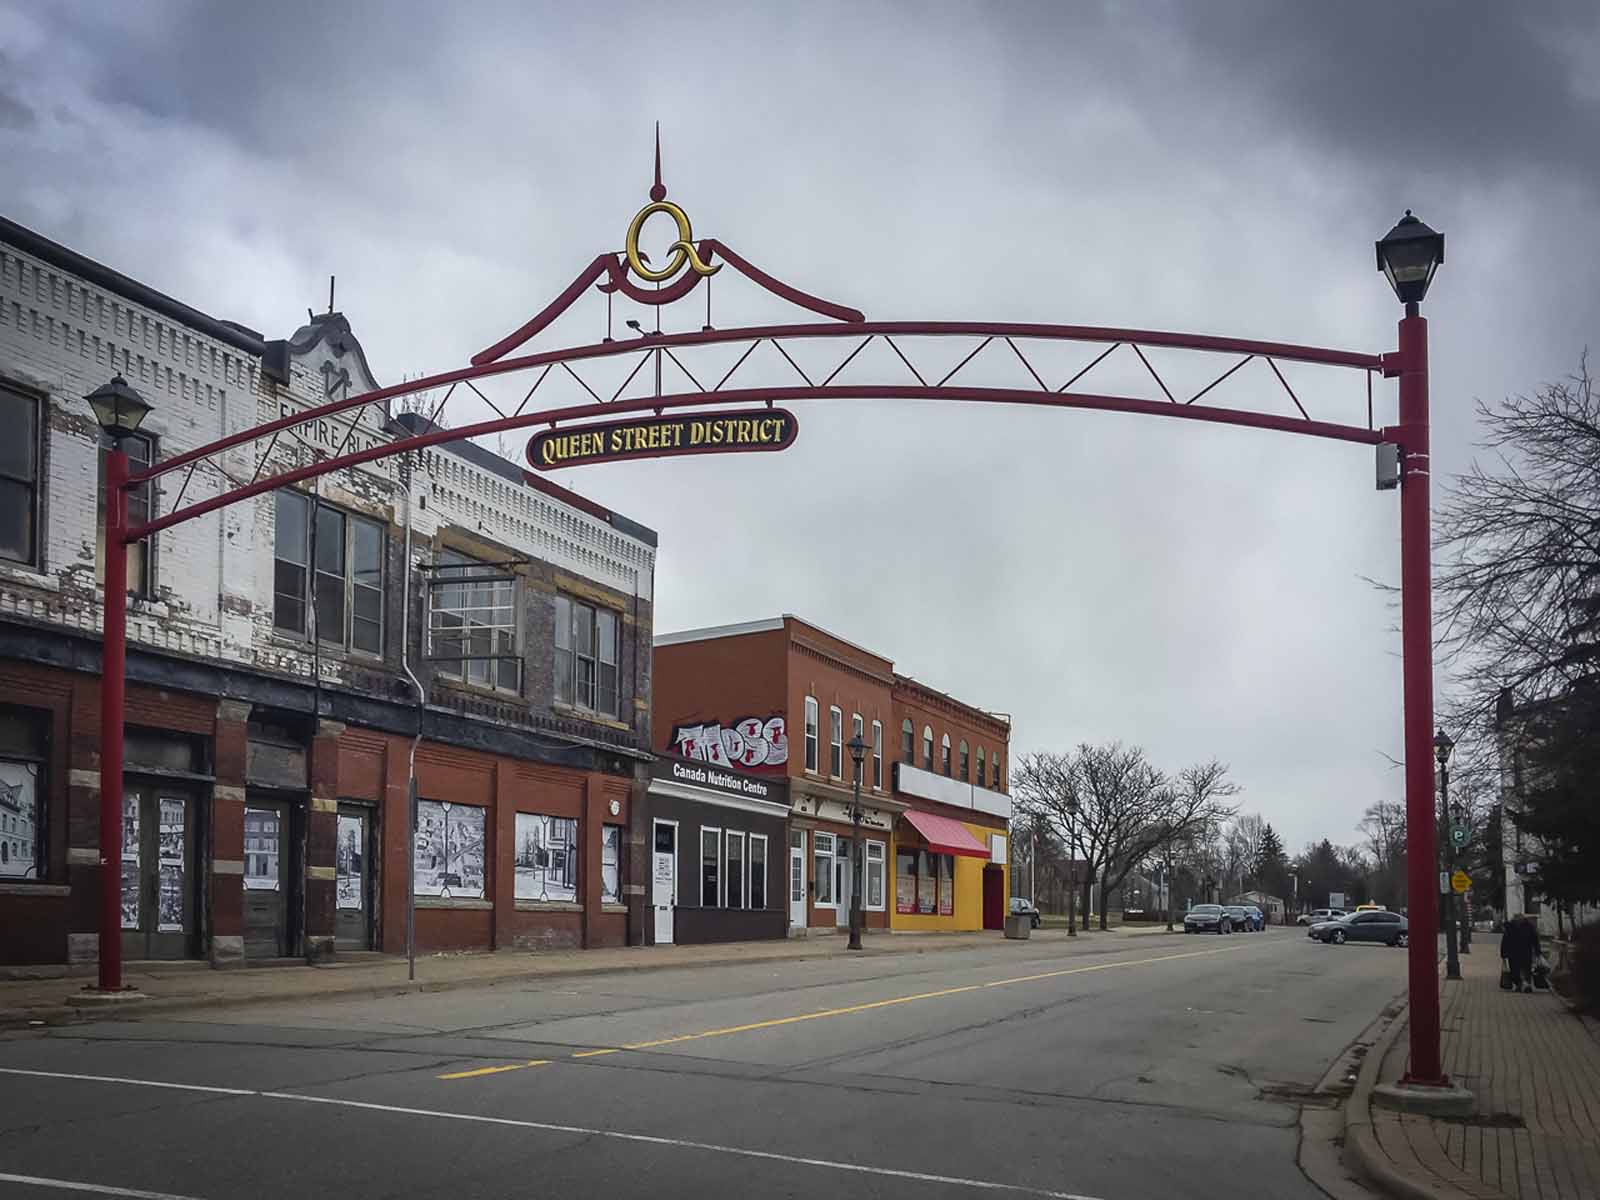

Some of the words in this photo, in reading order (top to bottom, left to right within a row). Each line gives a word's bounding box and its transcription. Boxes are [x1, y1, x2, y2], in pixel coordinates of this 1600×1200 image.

[626, 200, 724, 282] Q
[541, 431, 605, 465] QUEEN
[611, 423, 685, 451] STREET
[690, 418, 785, 446] DISTRICT
[673, 762, 706, 782] Canada
[708, 770, 741, 790] Nutrition
[743, 779, 768, 796] Centre
